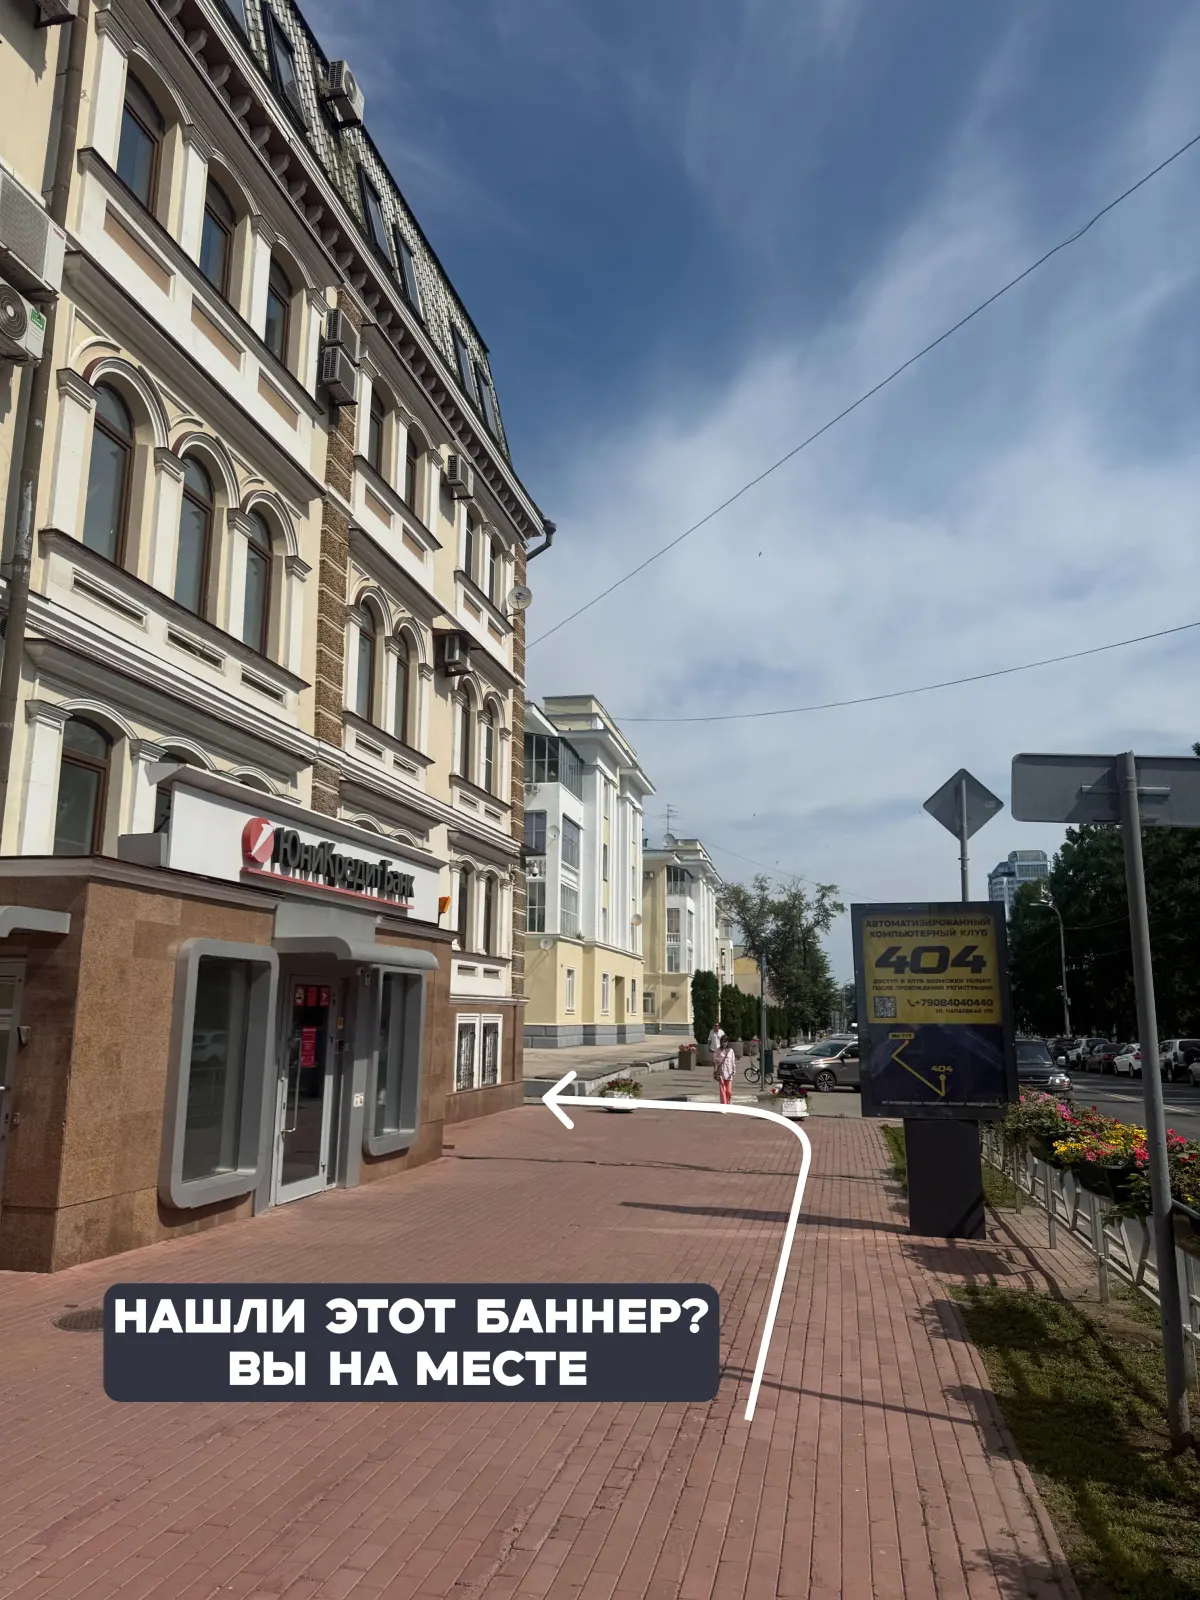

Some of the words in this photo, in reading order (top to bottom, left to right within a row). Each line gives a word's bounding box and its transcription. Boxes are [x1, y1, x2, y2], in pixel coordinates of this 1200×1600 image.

[866, 917, 991, 927] АВТОМАТИЗИРОВАННЫЙ
[869, 928, 957, 938] КОМПЬЮТЕРНЫЙ
[960, 929, 988, 937] КЛУБ
[874, 945, 987, 975] 404
